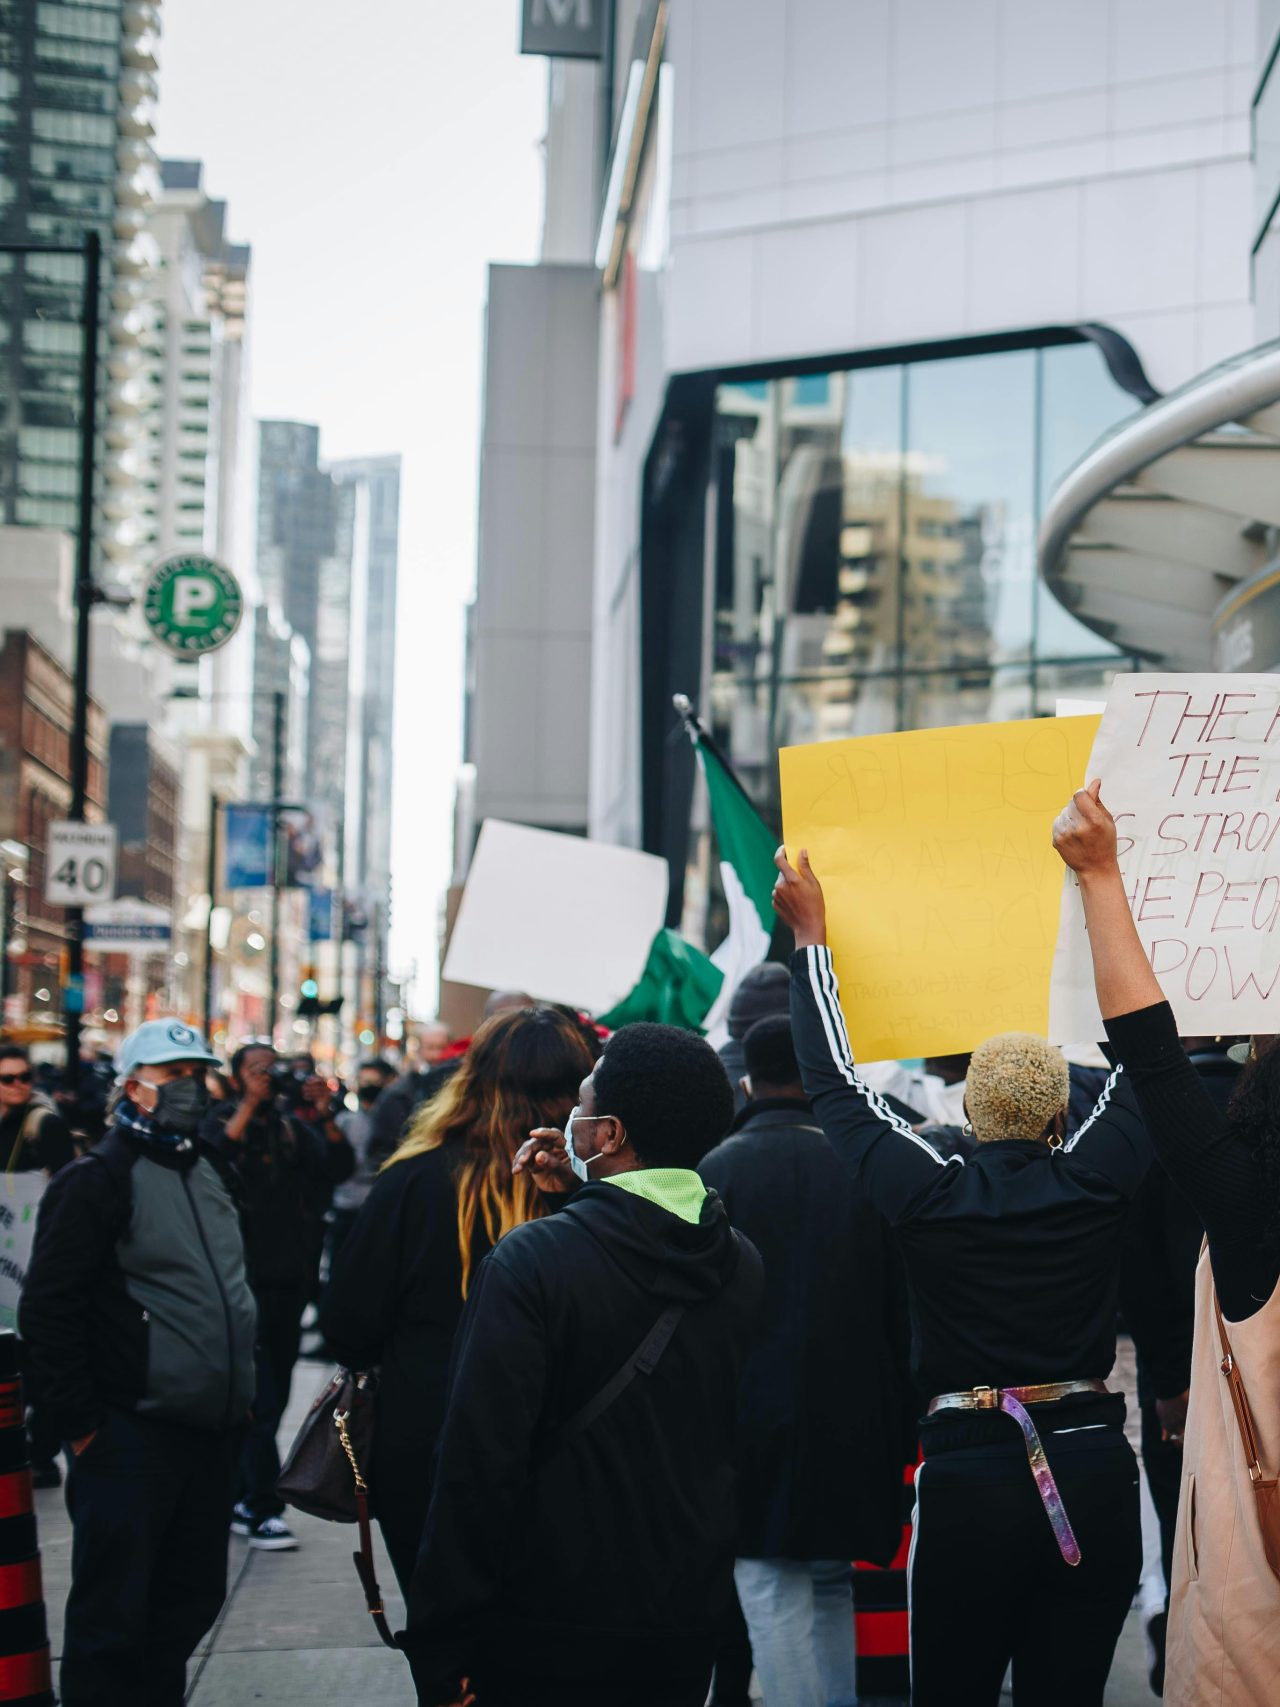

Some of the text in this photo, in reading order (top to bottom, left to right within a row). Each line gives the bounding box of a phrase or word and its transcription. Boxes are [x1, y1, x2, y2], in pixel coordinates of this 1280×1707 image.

[173, 575, 216, 628] P
[1135, 690, 1256, 746] THE
[1169, 751, 1260, 797] THE
[1113, 812, 1136, 857] S
[51, 854, 110, 895] 40
